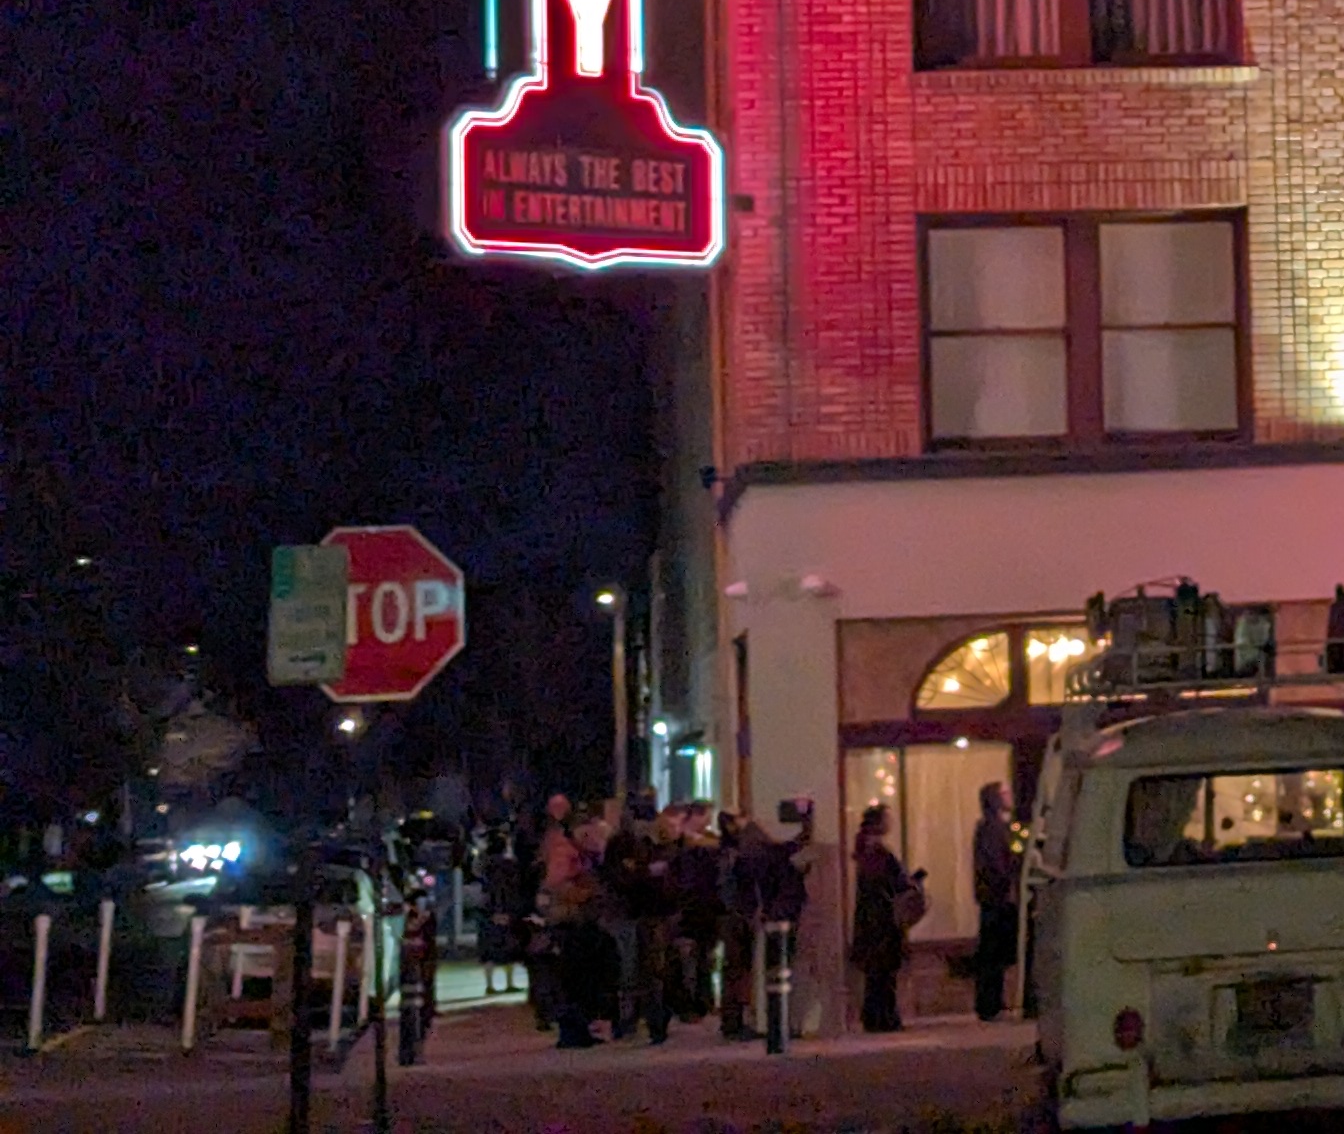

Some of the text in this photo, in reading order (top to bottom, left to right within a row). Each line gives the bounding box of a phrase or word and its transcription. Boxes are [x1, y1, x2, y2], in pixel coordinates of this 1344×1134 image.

[484, 151, 686, 194] ALWAYS THE BEST
[513, 192, 687, 232] ENTERTAINMENT
[347, 579, 451, 645] TOP
